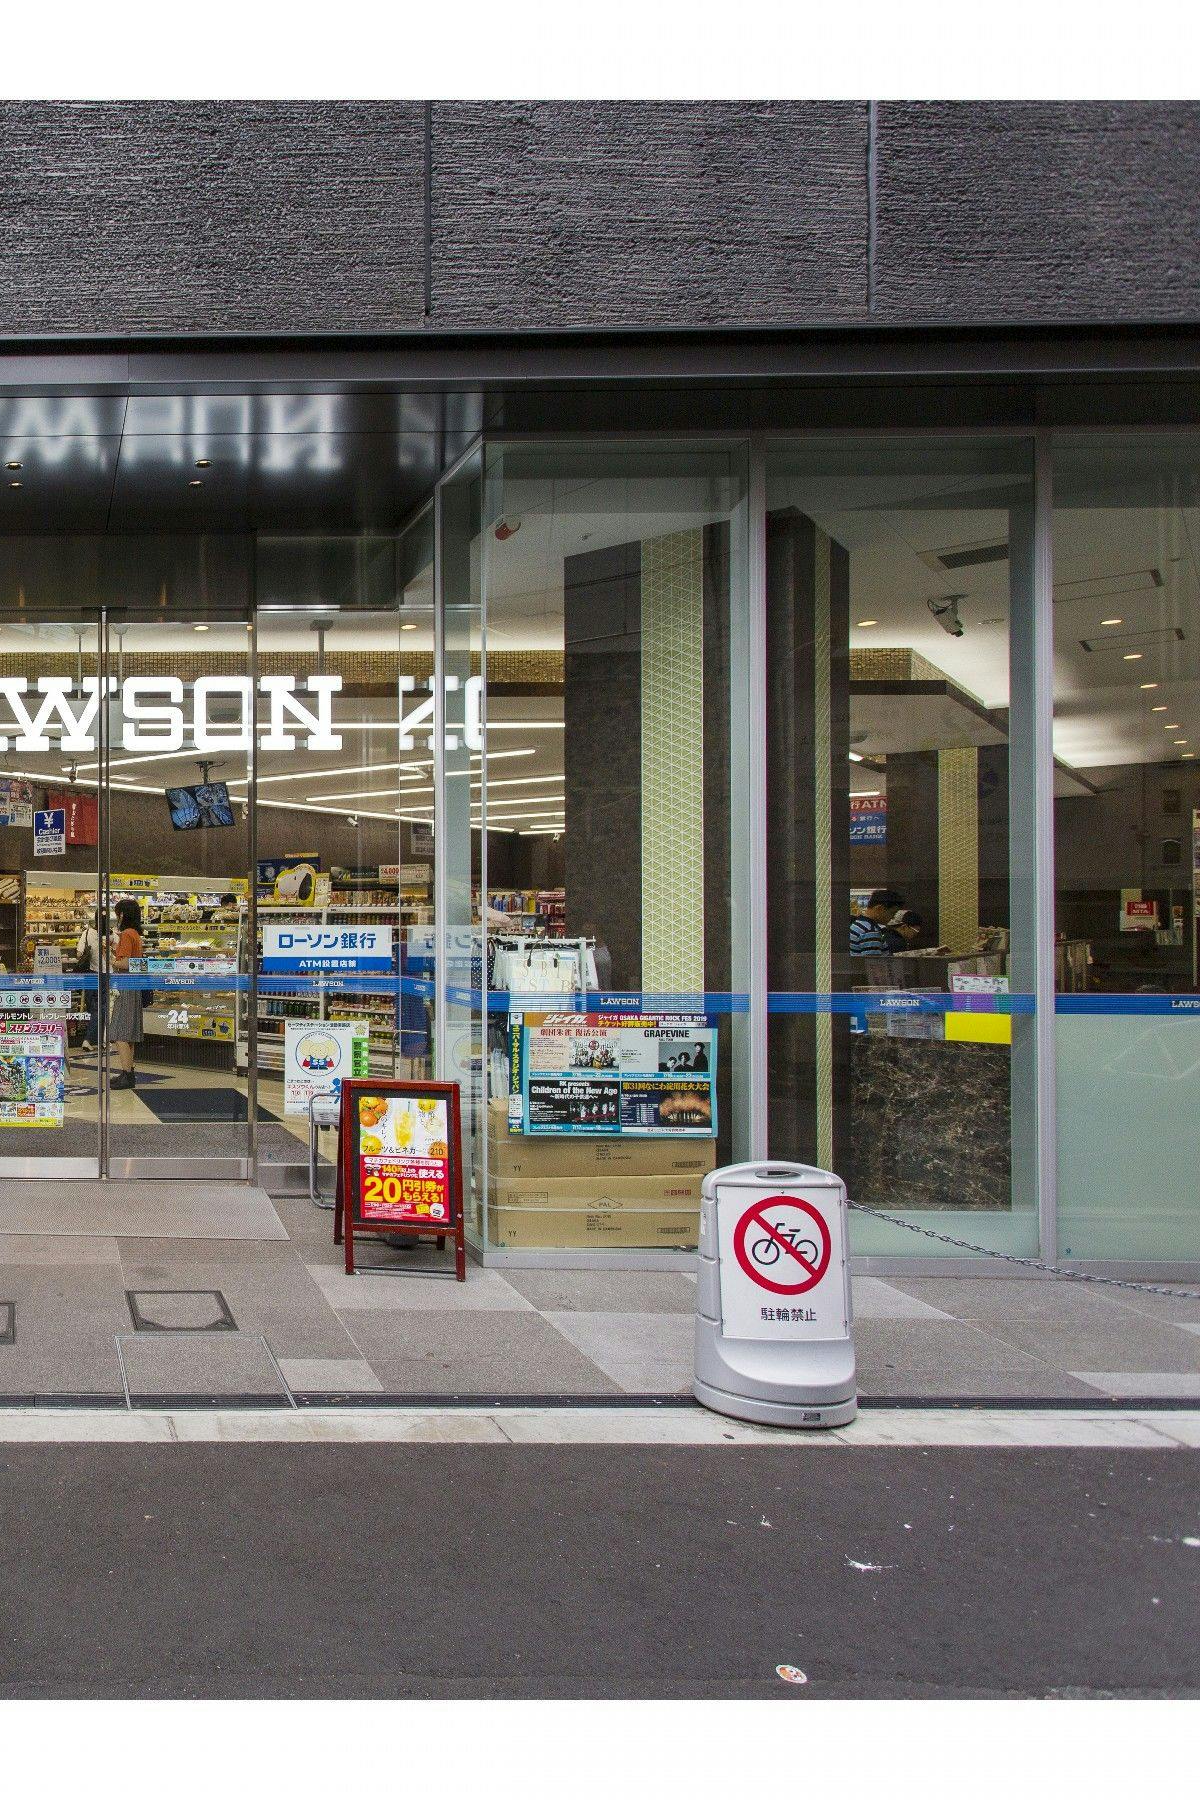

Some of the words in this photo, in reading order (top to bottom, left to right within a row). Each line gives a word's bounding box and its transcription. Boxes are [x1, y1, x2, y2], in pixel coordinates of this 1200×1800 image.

[38, 827, 61, 835] Cashier
[278, 932, 377, 949] ローソン銀行
[298, 959, 357, 968] ATM設置店舗
[600, 997, 640, 1005] LAWSON
[879, 999, 920, 1007] LAWSON
[1171, 1000, 1200, 1008] LAWS
[167, 1009, 189, 1024] 24
[644, 1029, 690, 1038] GRAPEVINE
[531, 1086, 561, 1094] Children
[562, 1086, 571, 1094] of
[572, 1086, 585, 1095] the
[585, 1086, 603, 1095] New
[603, 1087, 618, 1096] Age
[418, 1168, 445, 1179] 使える
[364, 1176, 402, 1203] 20
[402, 1179, 444, 1192] 円引券が
[402, 1191, 444, 1203] もらえる!
[760, 1307, 817, 1322] 駐輪禁止
